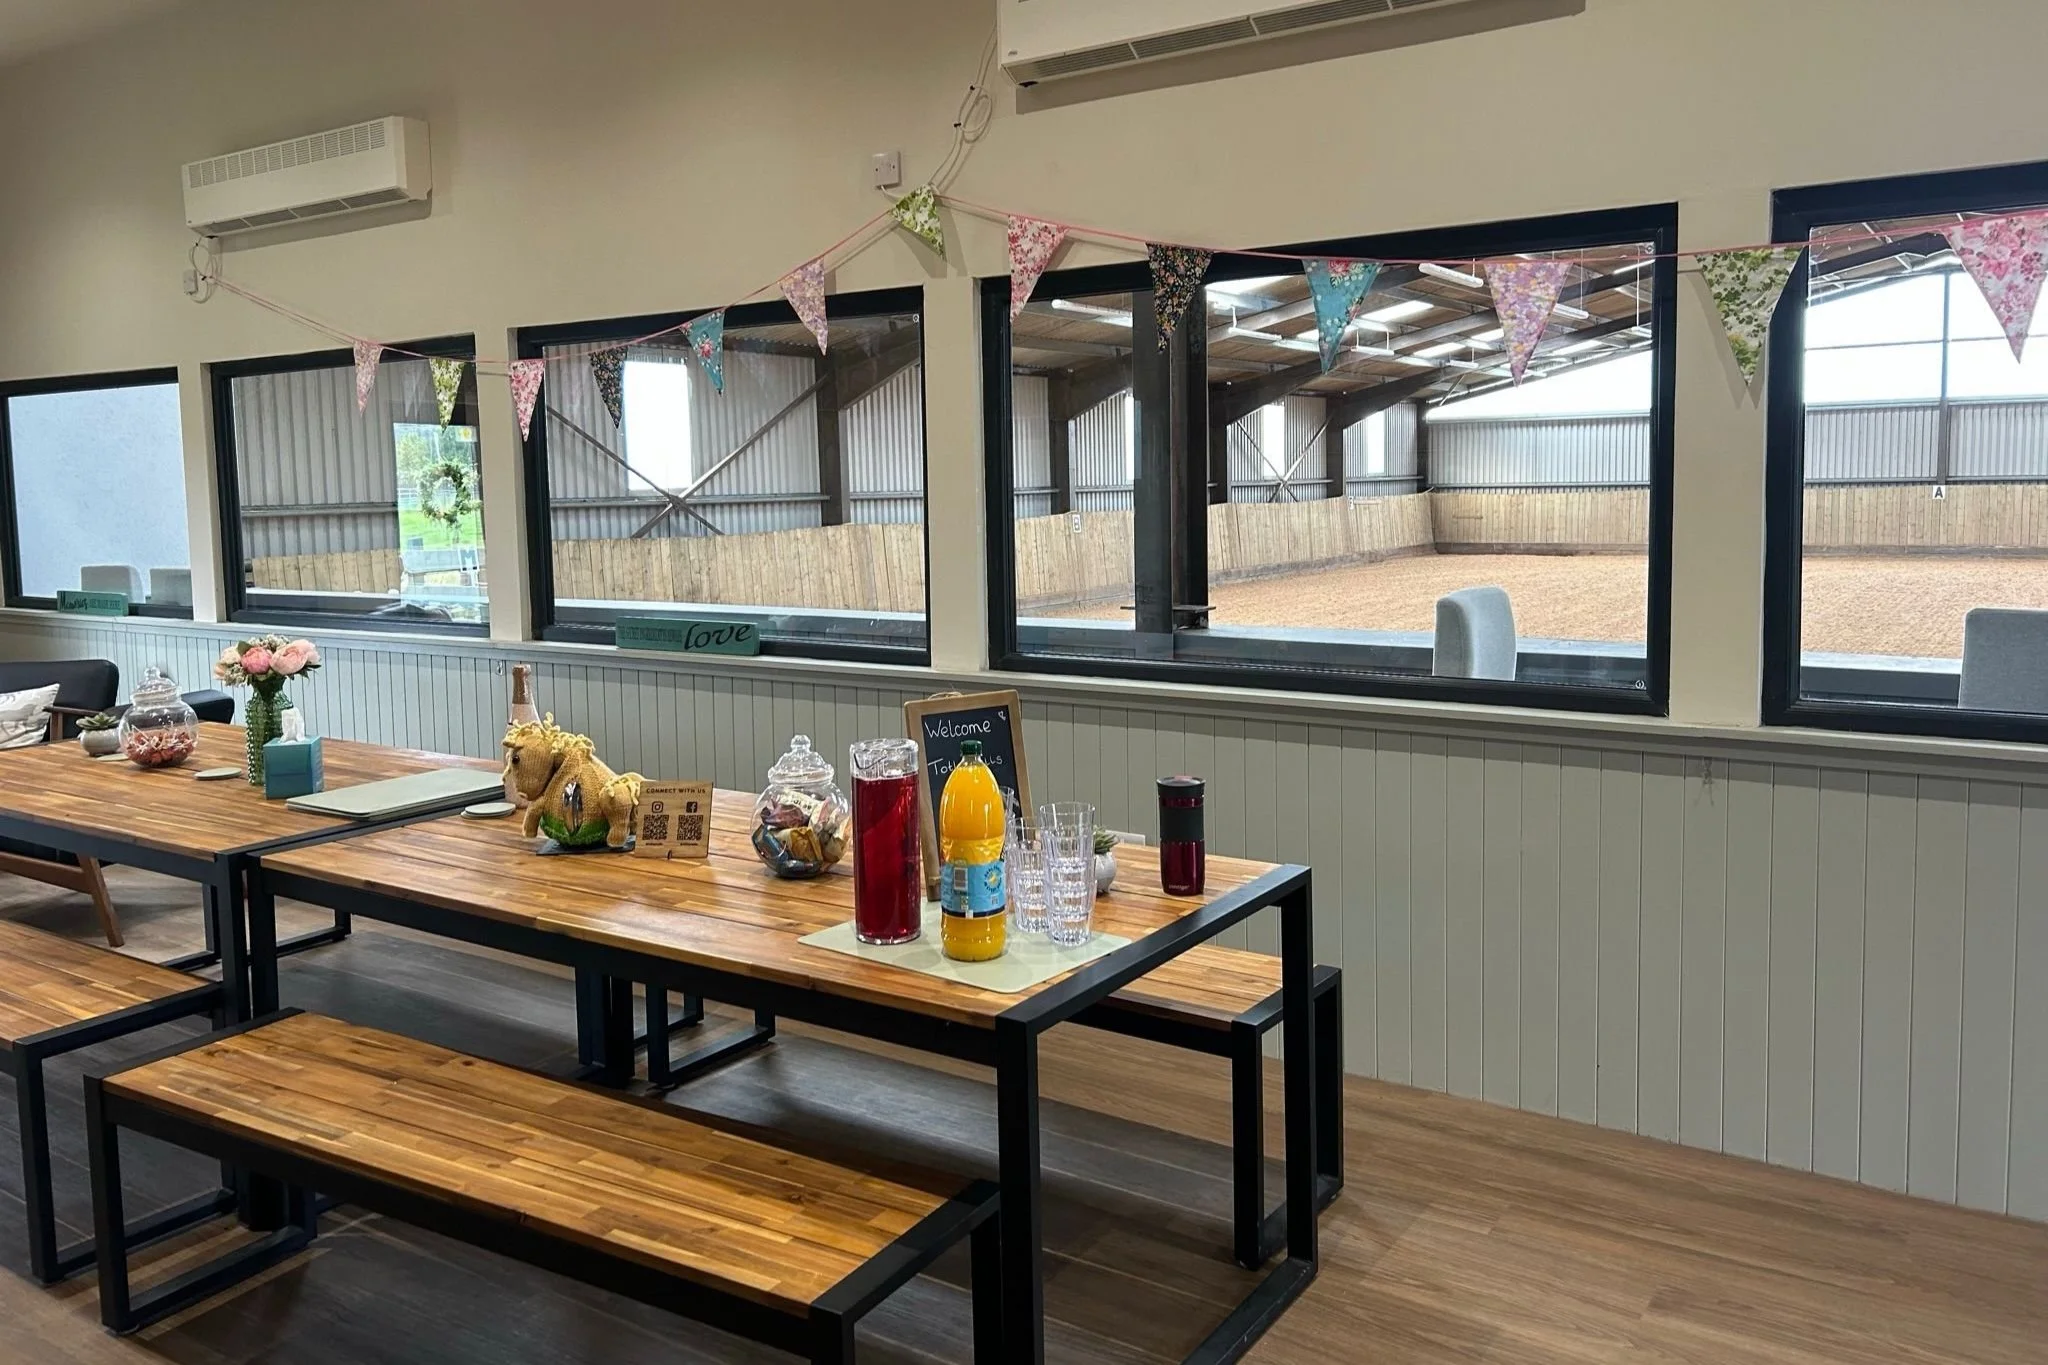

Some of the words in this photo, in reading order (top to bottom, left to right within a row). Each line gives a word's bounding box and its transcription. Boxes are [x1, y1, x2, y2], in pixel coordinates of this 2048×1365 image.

[1935, 487, 1943, 498] A
[460, 549, 477, 566] M
[684, 623, 752, 650] love
[924, 719, 992, 739] Welcome
